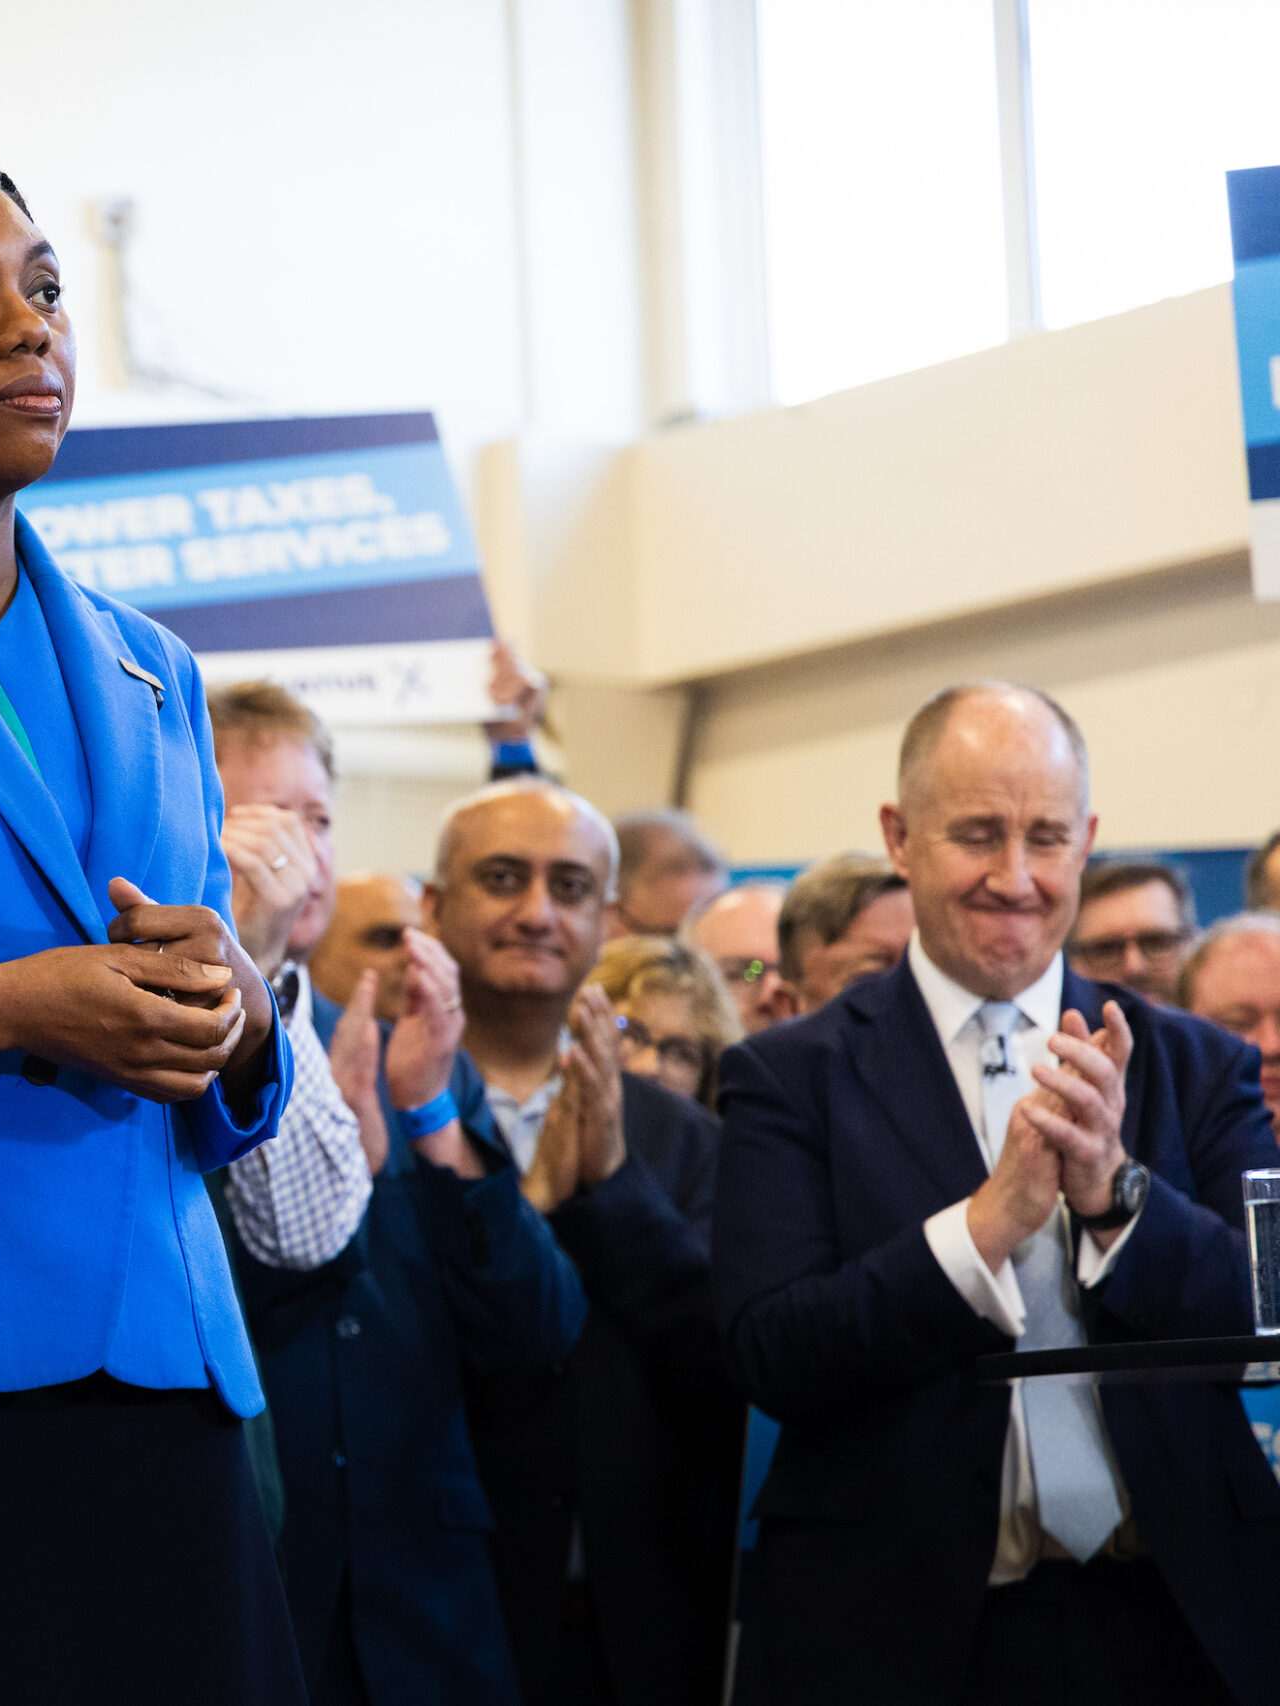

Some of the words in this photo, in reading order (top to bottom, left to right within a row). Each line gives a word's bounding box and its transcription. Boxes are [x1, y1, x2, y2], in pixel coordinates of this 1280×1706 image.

[29, 493, 191, 548] OWER
[55, 545, 174, 589] TER
[181, 513, 450, 582] SERVICES
